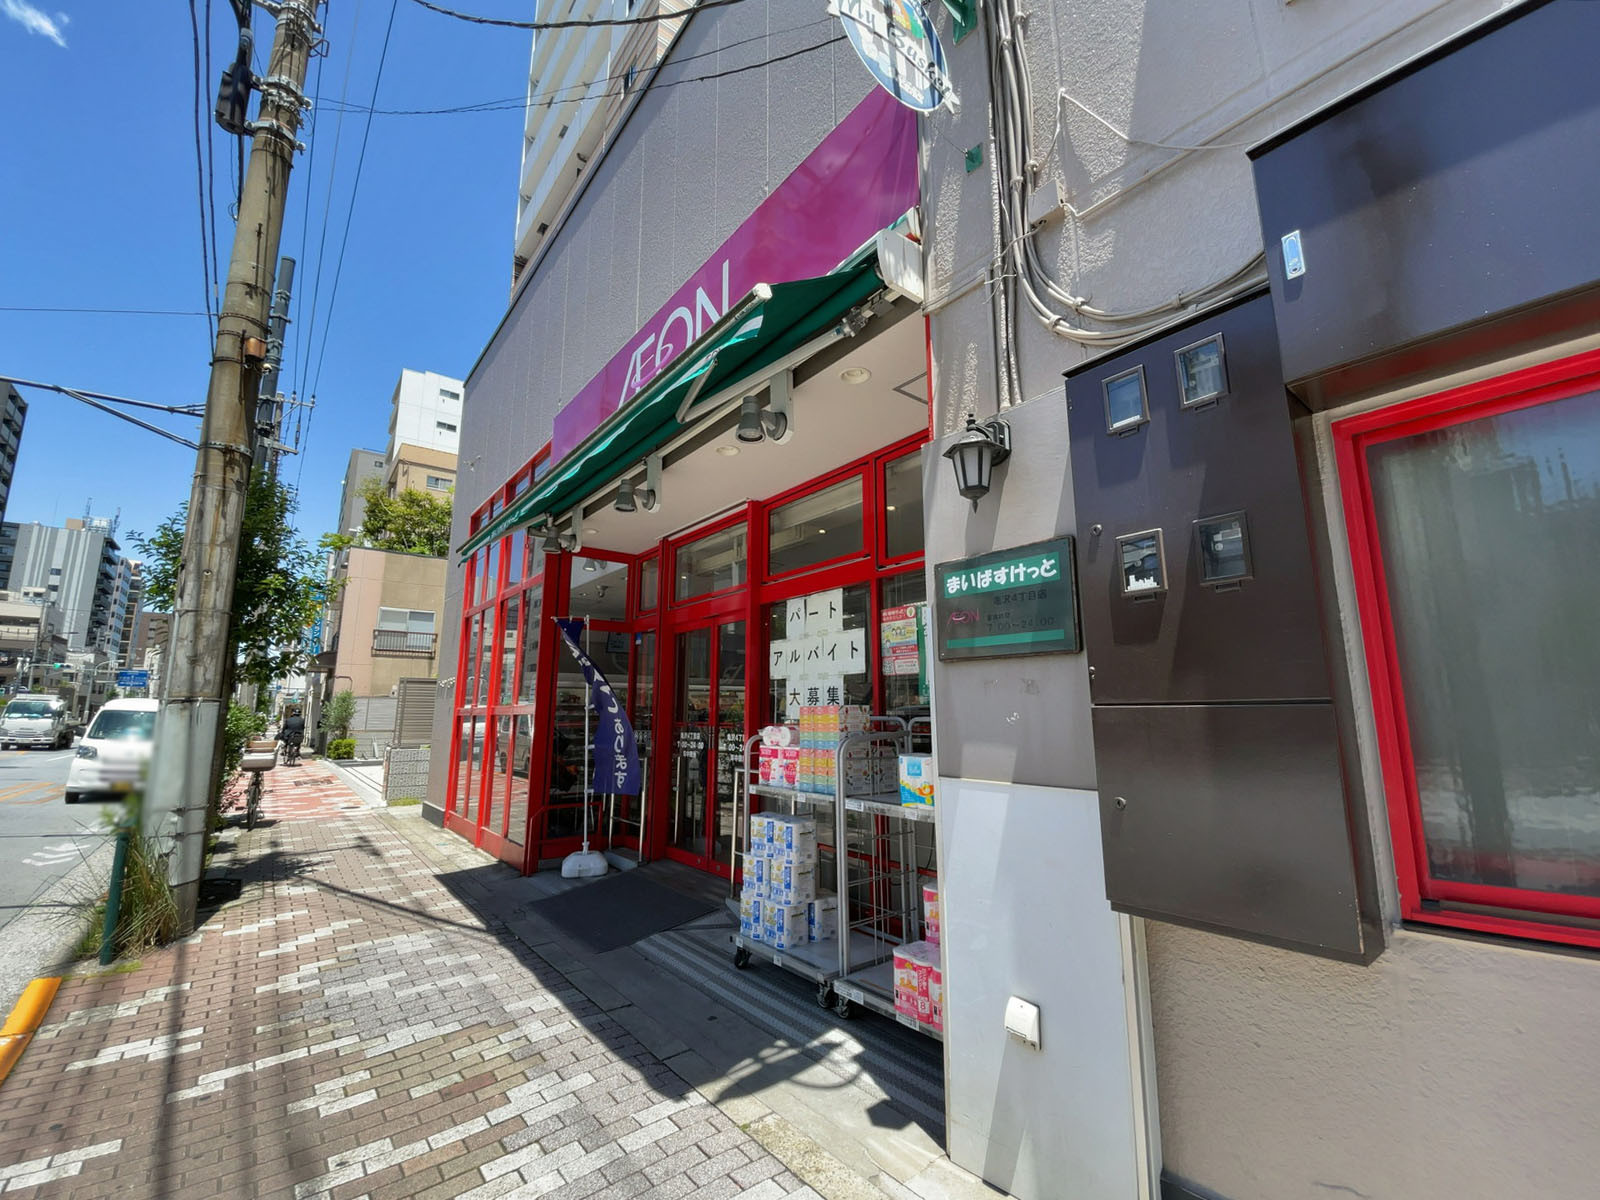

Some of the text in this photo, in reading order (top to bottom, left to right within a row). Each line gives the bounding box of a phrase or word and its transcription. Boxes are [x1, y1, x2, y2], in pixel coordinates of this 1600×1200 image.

[946, 558, 1057, 594] まいばすけっと
[789, 600, 838, 623] パート
[773, 640, 859, 667] アルバイト
[789, 686, 840, 706] 大募集
